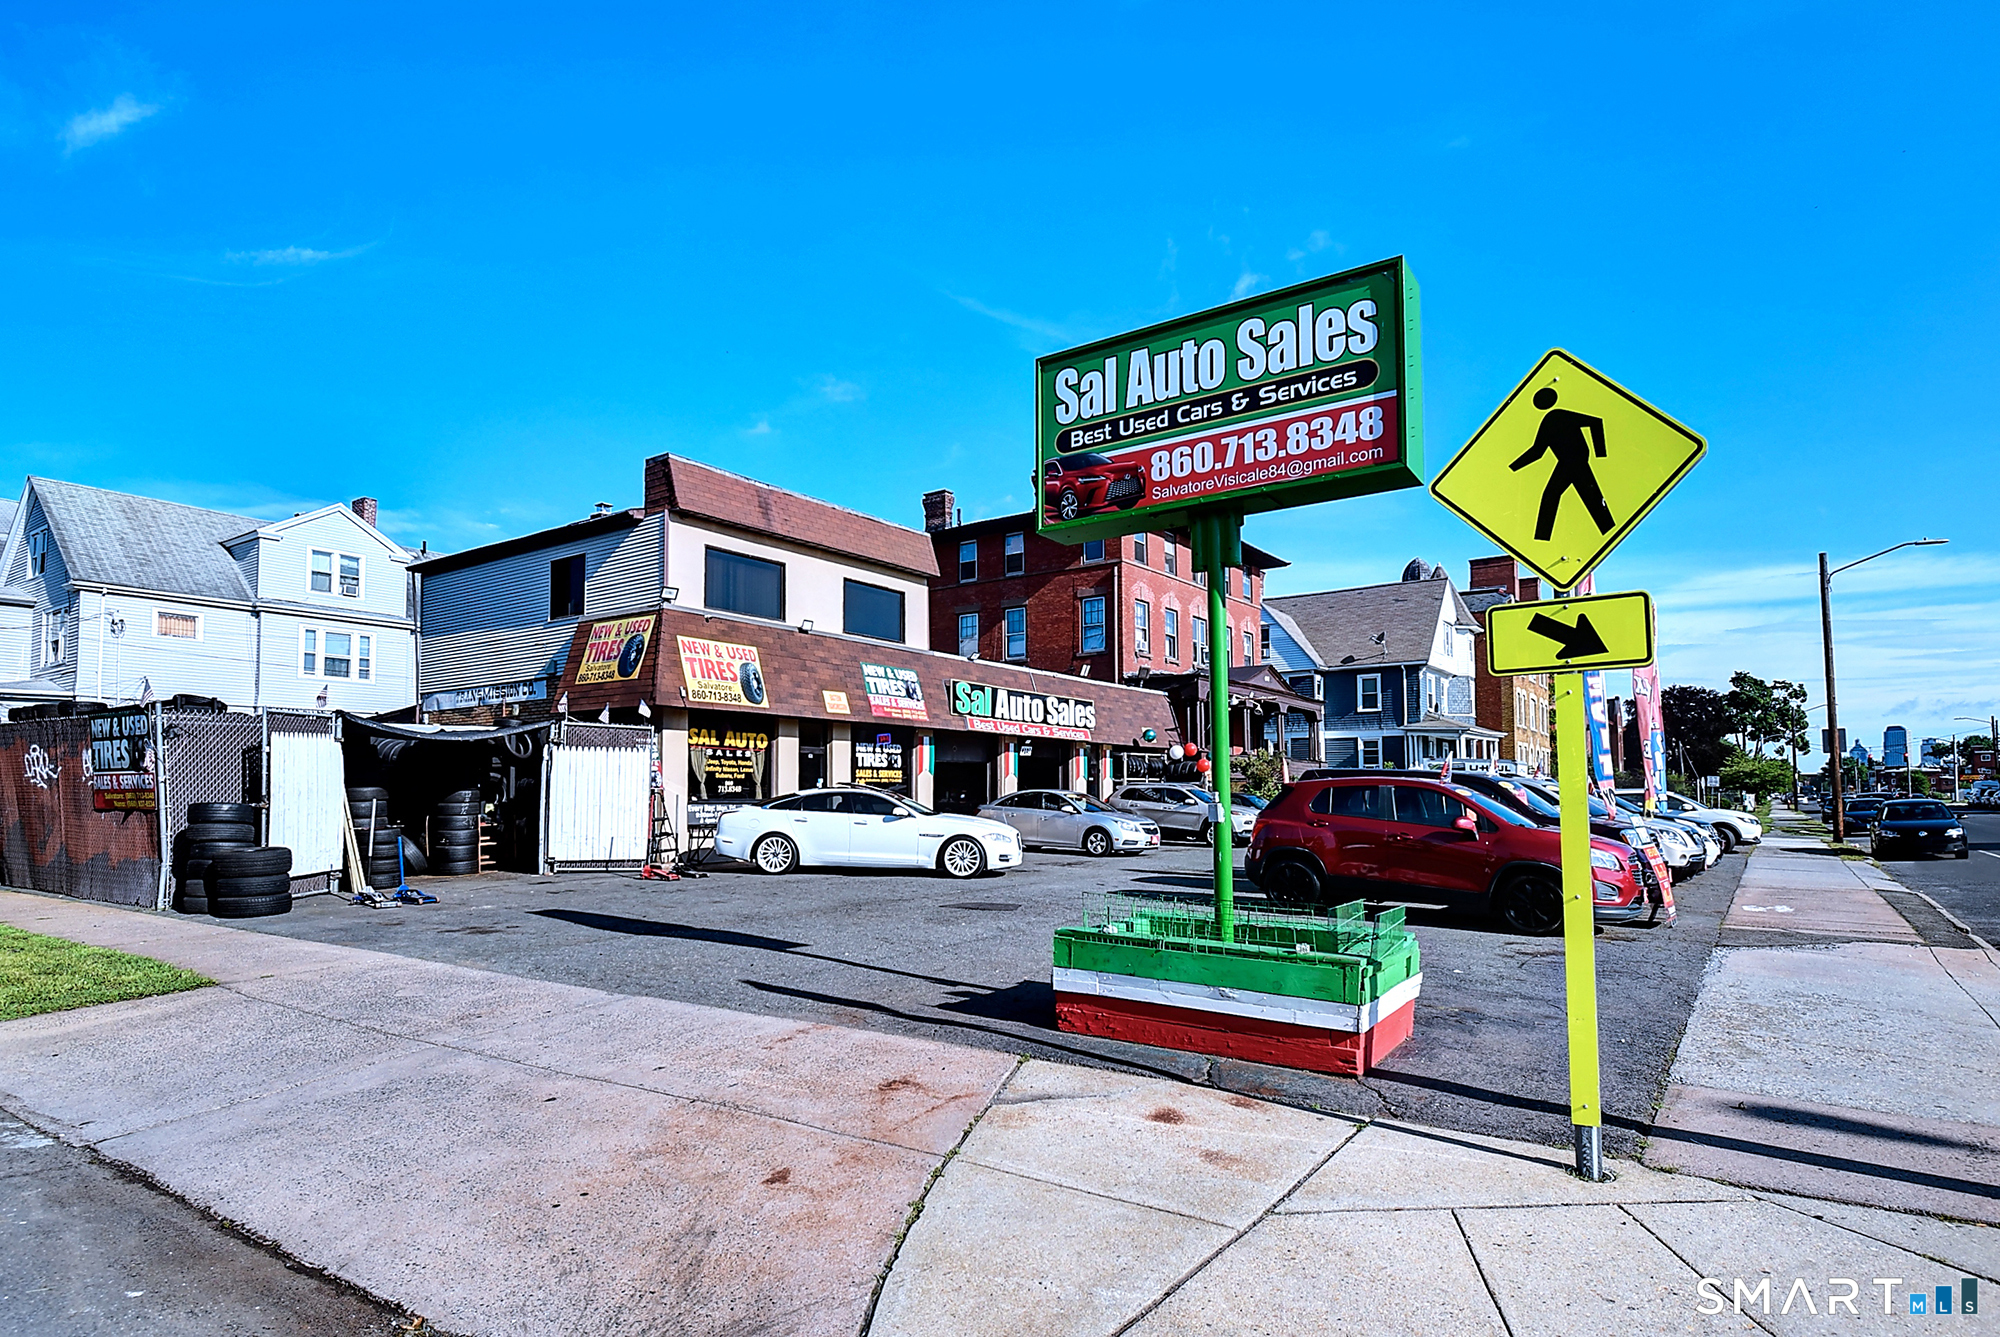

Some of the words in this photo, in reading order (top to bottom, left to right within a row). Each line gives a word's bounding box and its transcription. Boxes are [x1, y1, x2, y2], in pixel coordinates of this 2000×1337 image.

[1055, 356, 1118, 424] Sal
[1126, 338, 1226, 409] Auto
[1236, 300, 1378, 381] Sales
[1071, 425, 1112, 448] Best
[1119, 411, 1169, 437] Used
[1177, 400, 1222, 425] Cars
[1230, 394, 1250, 411] &
[1258, 371, 1357, 406] Services
[1150, 406, 1384, 482] 860.713.8348
[1152, 446, 1384, 500] SalvatoreVisicale84@gmail.com
[591, 624, 615, 639] NEW
[615, 622, 623, 636] &
[625, 619, 651, 634] USED
[586, 638, 624, 663] TIRES
[681, 640, 710, 655] NEW
[714, 645, 723, 658] &
[726, 646, 756, 662] USED
[684, 657, 738, 682] TIRES
[862, 664, 885, 677] NEW
[885, 667, 895, 679] &
[894, 669, 918, 682] USED
[456, 683, 520, 704] TRANSMISSION
[522, 681, 537, 696] CO.
[691, 690, 742, 702] 860-713-8348
[697, 681, 735, 692] Salvatore:
[865, 677, 906, 697] TIRES
[955, 681, 992, 717] Sal
[995, 689, 1044, 722] Auto
[1046, 696, 1096, 728] Sales
[91, 718, 111, 738] NEW
[113, 717, 120, 737] &
[122, 715, 148, 736] USED
[973, 719, 995, 730] Best
[997, 721, 1020, 733] Used
[1021, 724, 1041, 735] Cars
[1044, 727, 1052, 736] &
[1054, 728, 1086, 739] Services
[688, 728, 720, 745] SAL
[724, 731, 768, 749] AUTO
[856, 742, 874, 753] NEW
[882, 743, 902, 754] USED
[92, 739, 130, 769] TIRES
[706, 749, 751, 757] SALES
[856, 753, 888, 767] TIRES
[94, 775, 111, 789] SALES
[112, 775, 119, 789] &
[120, 774, 154, 789] SERVICES
